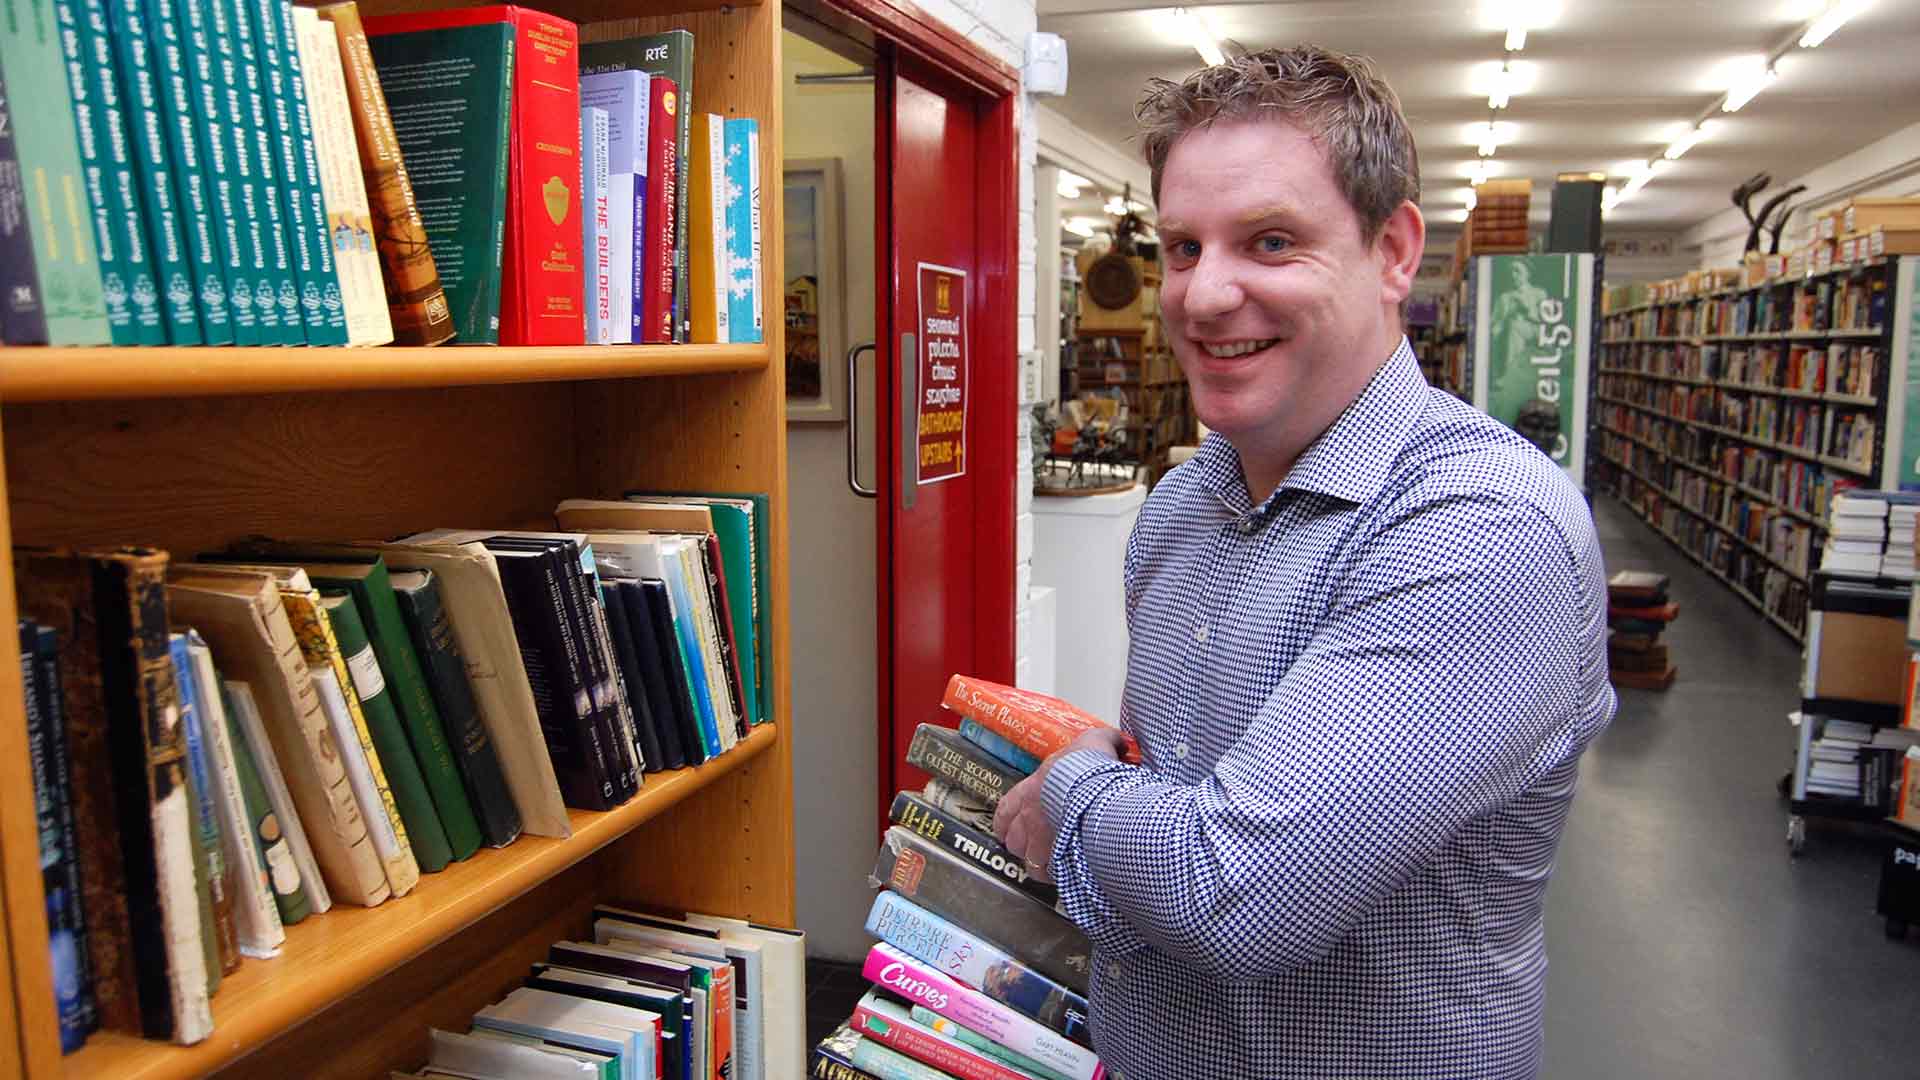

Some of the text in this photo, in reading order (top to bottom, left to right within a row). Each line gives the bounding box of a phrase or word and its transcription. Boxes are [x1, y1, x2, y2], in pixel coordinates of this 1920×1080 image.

[242, 41, 253, 61] of
[267, 47, 278, 66] of
[289, 54, 299, 71] of
[645, 43, 669, 62] RTÉ
[245, 64, 257, 90] the
[271, 69, 283, 95] the
[292, 76, 304, 100] the
[250, 92, 263, 127] Irish
[275, 98, 288, 131] Irish
[296, 103, 309, 136] Irish
[256, 129, 272, 179] Nation
[281, 134, 296, 182] Nation
[302, 139, 317, 186] Nation
[667, 140, 676, 176] HOW
[399, 166, 422, 228] Ireland
[665, 181, 675, 244] IRELAND
[751, 186, 759, 230] What
[265, 186, 287, 269] Bryan Fanning
[289, 188, 310, 271] Bryan Fanning
[310, 191, 330, 273] Bryan Fanning
[597, 195, 610, 320] THE BUILDERS
[633, 248, 641, 299] SPOTLIGHT
[919, 410, 963, 436] BATHROOMS
[919, 441, 953, 467] UPSTAIRS
[955, 680, 969, 701] The
[996, 705, 1026, 734] Places
[926, 752, 1003, 801] OLDEST PROFESSIO
[943, 746, 1003, 788] THE SECOND
[952, 832, 1031, 884] TRILOGY
[881, 902, 954, 951] DEIRDRE
[880, 961, 949, 1010] Curves
